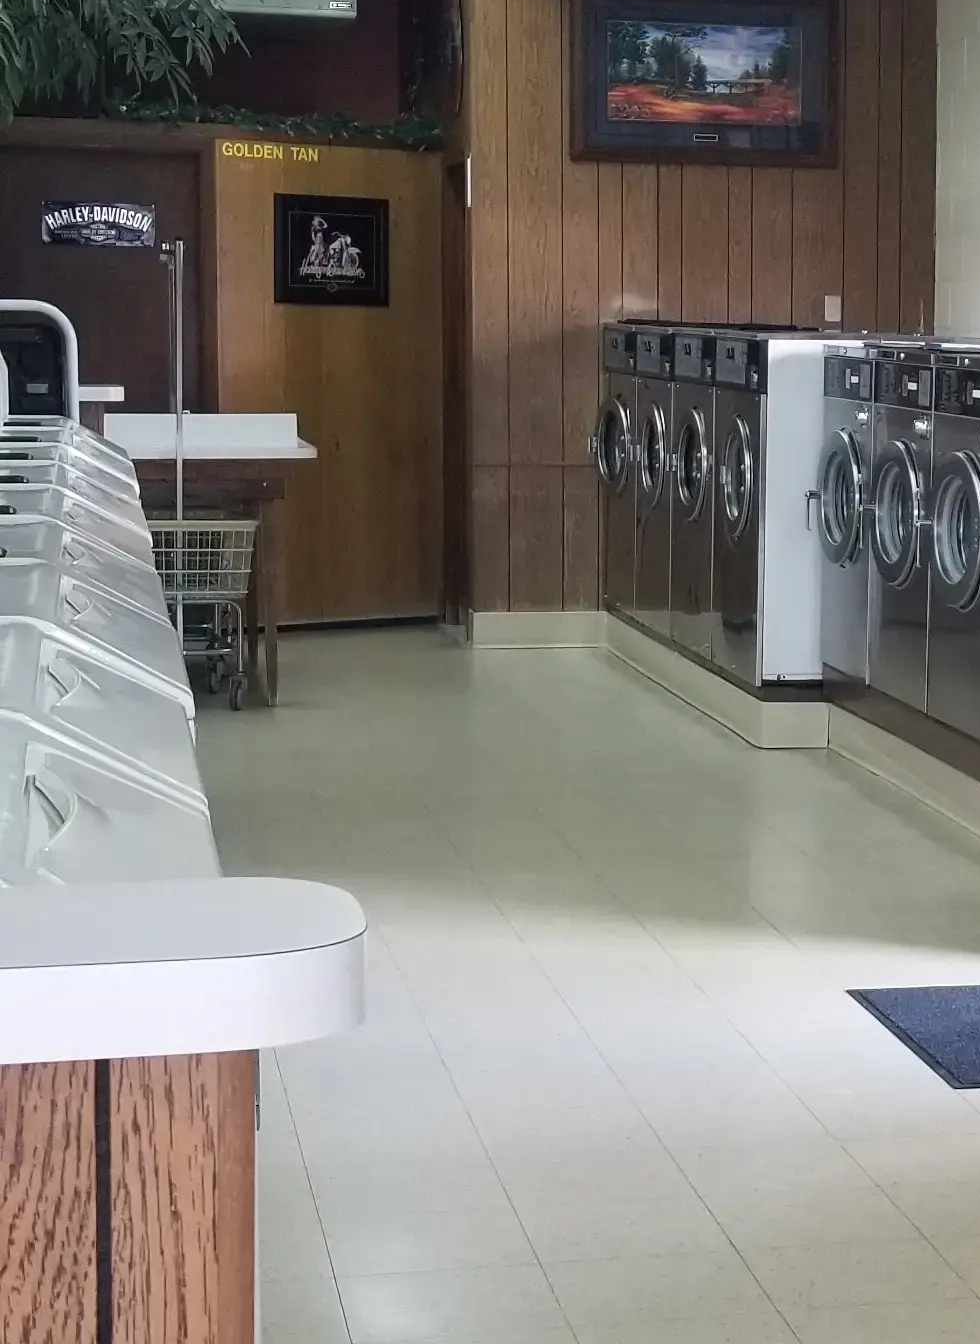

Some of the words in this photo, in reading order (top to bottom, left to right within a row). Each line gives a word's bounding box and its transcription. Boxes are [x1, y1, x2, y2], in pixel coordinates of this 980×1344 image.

[222, 142, 284, 160] GOLDEN
[290, 146, 319, 162] TAN
[44, 205, 153, 233] HARLEY-DAVIDSON
